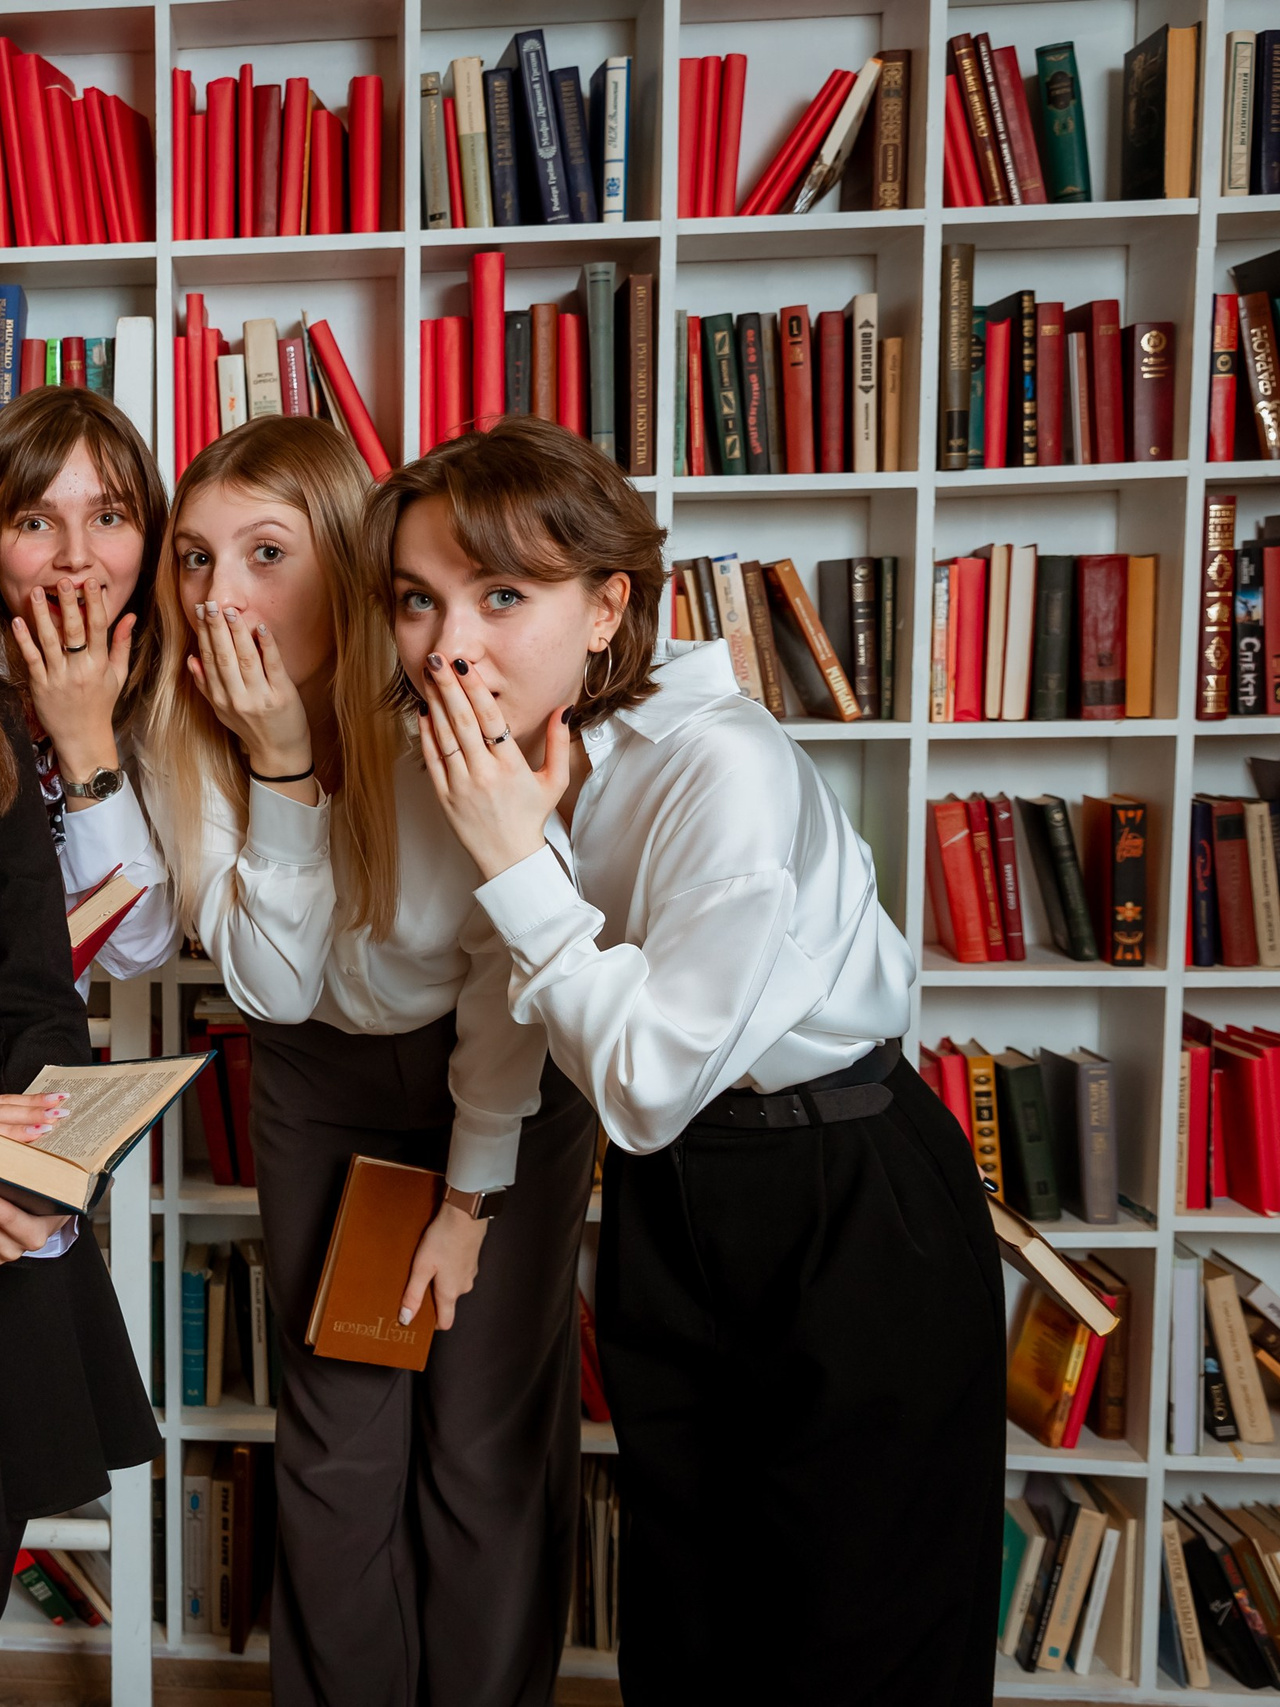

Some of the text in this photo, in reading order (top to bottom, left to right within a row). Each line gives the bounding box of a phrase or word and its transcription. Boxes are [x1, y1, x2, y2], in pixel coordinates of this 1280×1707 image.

[527, 52, 550, 145] Мифы Древней Греции
[1240, 72, 1248, 145] ВОСПОМИНАНИЯ
[544, 160, 561, 210] Роберт Грейвс
[4, 319, 13, 403] НОВЫЕ ОТКРЫТИЯ
[636, 286, 646, 464] ИСТОРИЯ РУССКОГО ИСКУССТВА
[861, 332, 872, 381] ВЯЗАНИЕ
[1249, 327, 1274, 395] ФАРАОН
[827, 665, 855, 714] КУРАНТЫ
